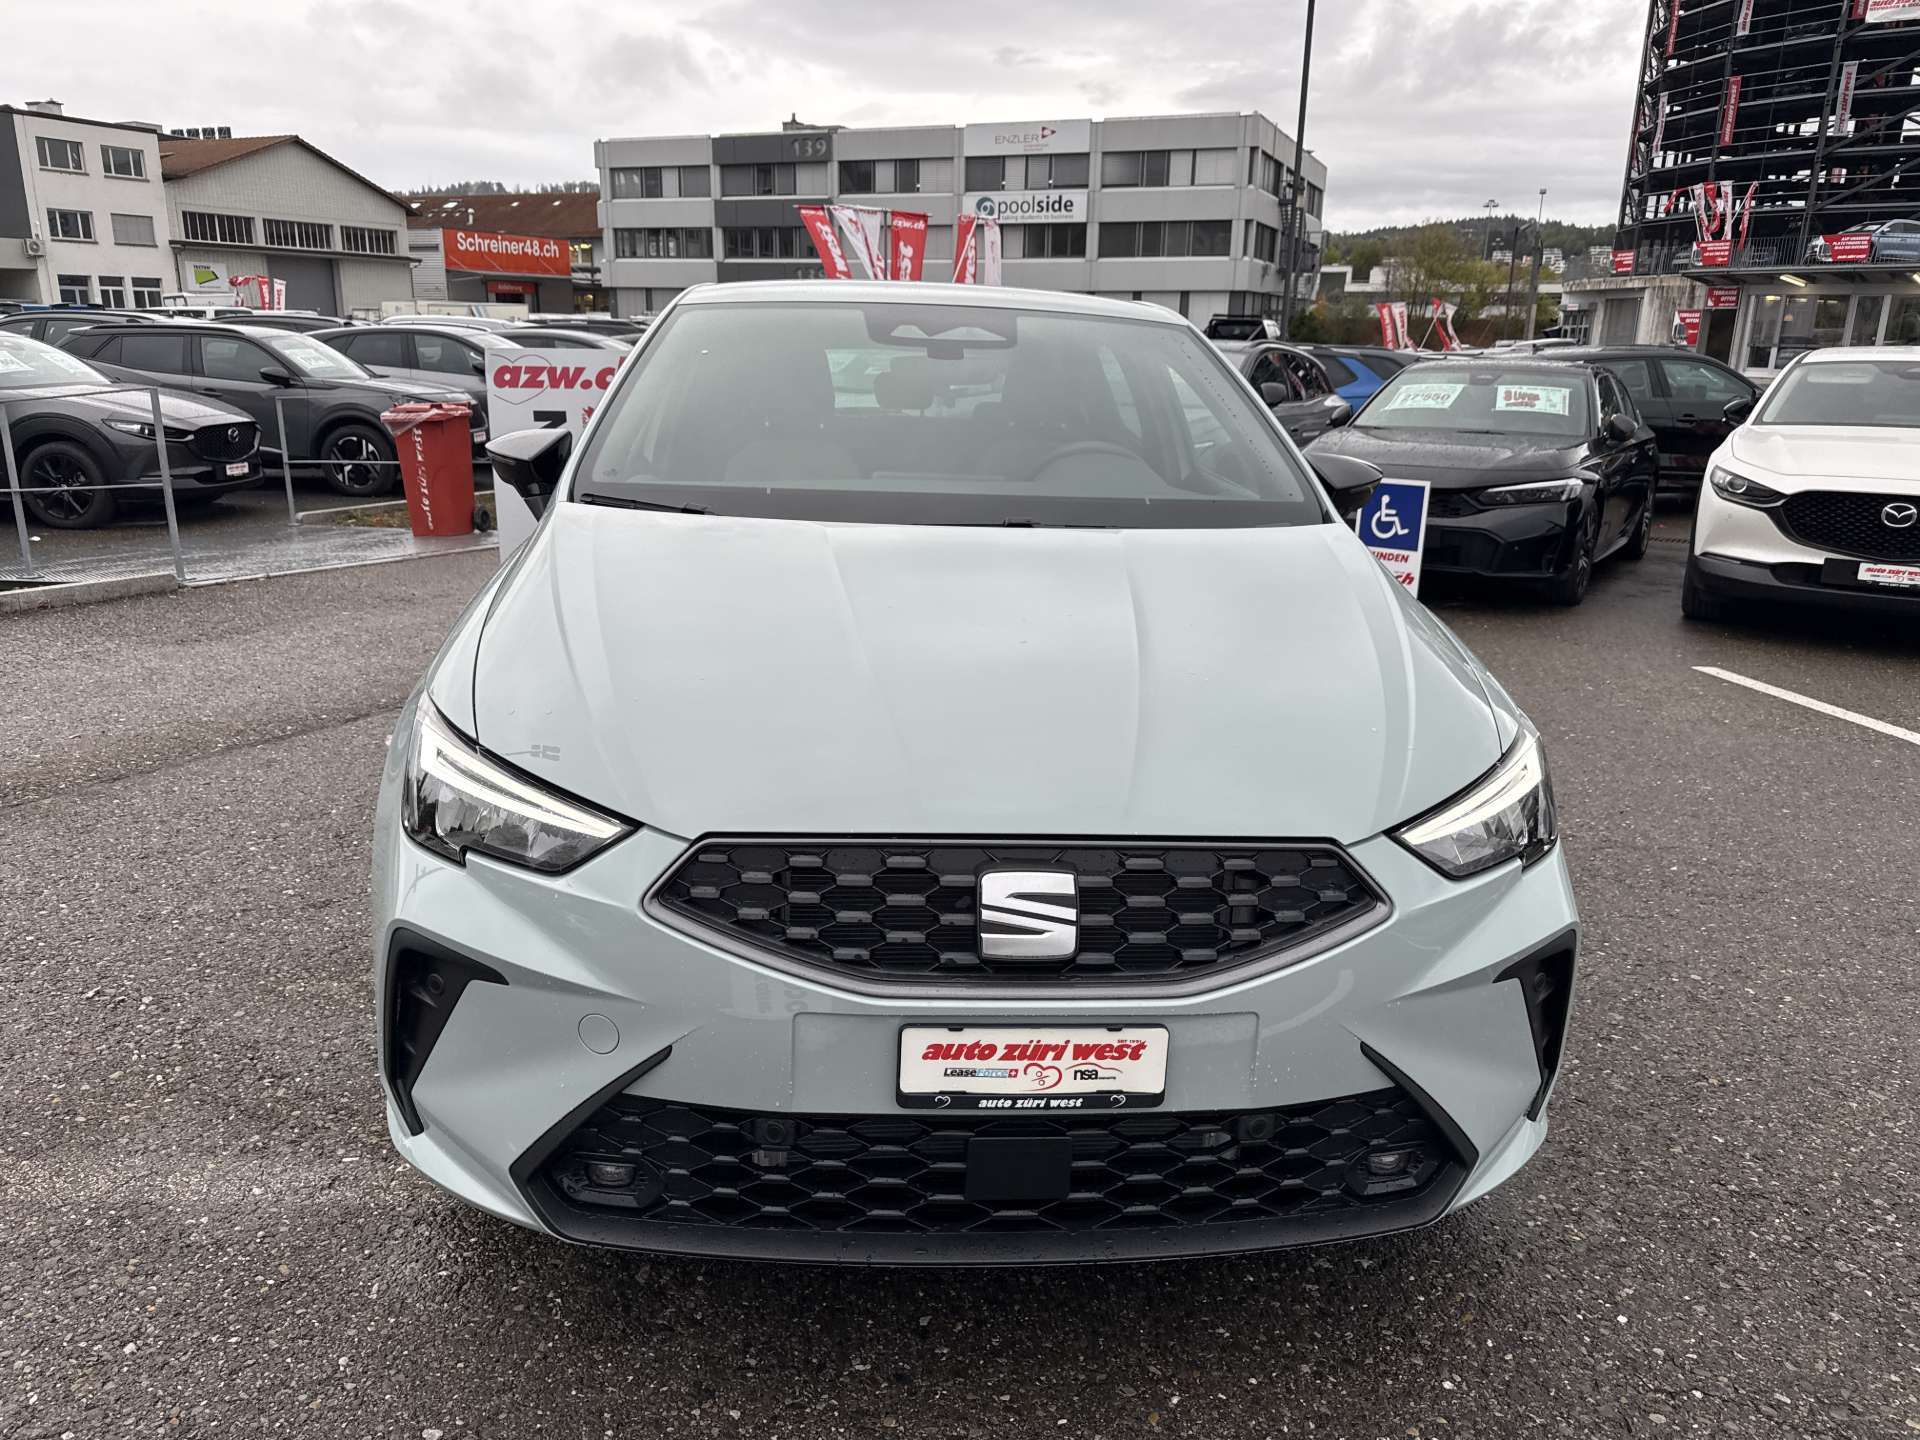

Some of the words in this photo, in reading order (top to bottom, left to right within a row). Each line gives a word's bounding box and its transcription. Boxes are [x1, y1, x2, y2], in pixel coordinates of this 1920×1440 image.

[792, 137, 827, 158] 139
[995, 133, 1040, 145] ENZLER
[998, 194, 1074, 220] poolside
[456, 231, 560, 259] Schreiner48.ch
[493, 355, 627, 391] azw.c
[1373, 551, 1409, 563] UNDEN
[921, 1040, 998, 1061] auto
[997, 1039, 1071, 1062] züri
[1072, 1040, 1148, 1062] west
[943, 1067, 1009, 1078] LeaseForce
[1073, 1068, 1099, 1081] nsa
[978, 1098, 1013, 1109] auto
[1015, 1097, 1047, 1108] züri
[1050, 1097, 1084, 1108] west
